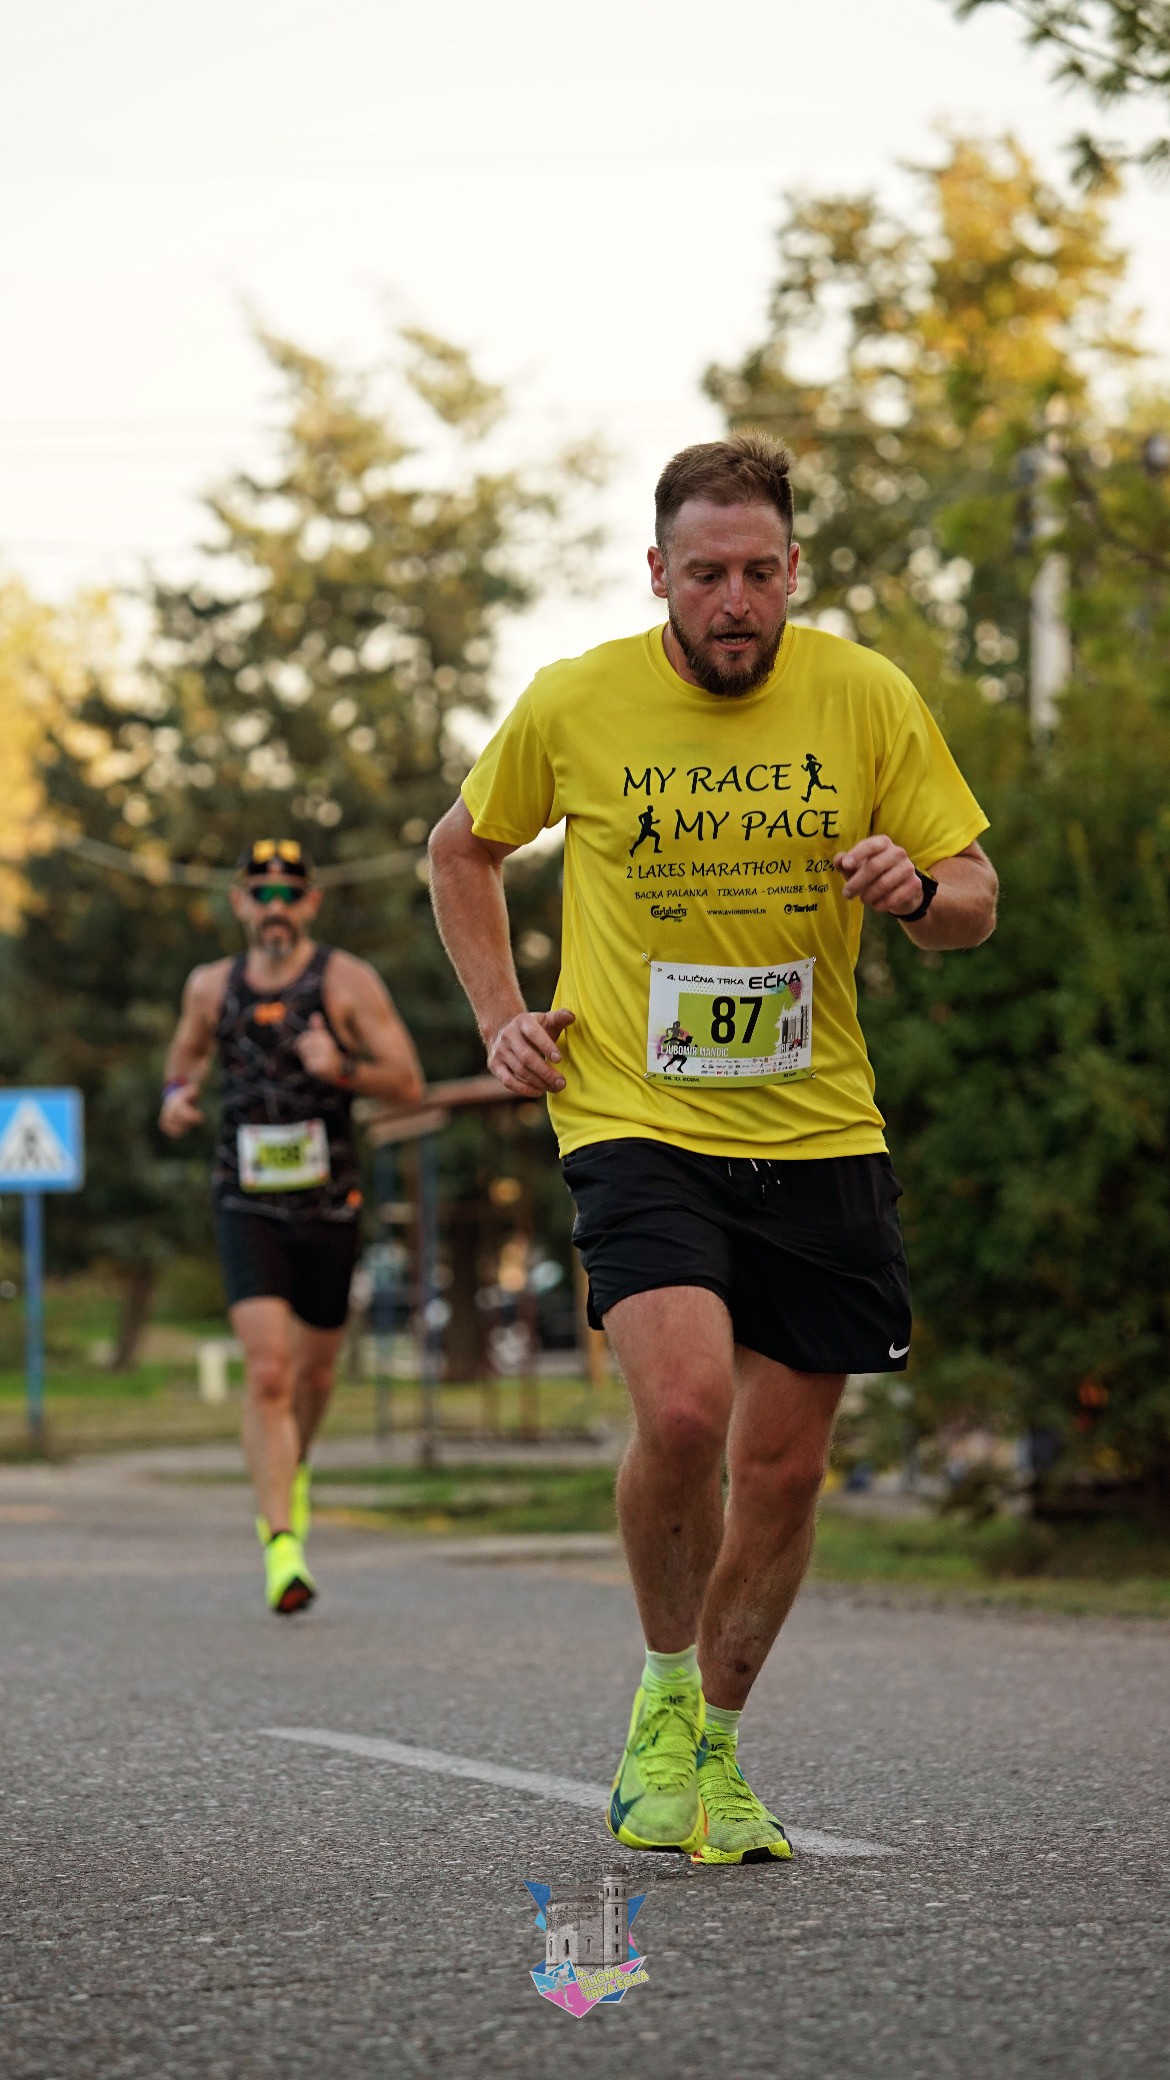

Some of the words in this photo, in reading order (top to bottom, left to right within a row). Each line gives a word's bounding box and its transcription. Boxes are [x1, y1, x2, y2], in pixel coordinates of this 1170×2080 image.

[623, 766, 676, 797] MY
[687, 763, 792, 794] RACE
[675, 809, 730, 841] MY
[741, 809, 840, 841] PACE
[626, 866, 633, 879] 2
[638, 862, 686, 879] LAKES
[691, 859, 792, 877] MARATHON
[634, 890, 664, 900] BACKA
[666, 888, 709, 898] PALANKA
[717, 887, 758, 897] TIKVARA
[650, 904, 688, 919] Carlsberg
[666, 974, 676, 982] 4.
[678, 974, 715, 985] ULIČNA
[716, 977, 745, 986] TRKA
[748, 971, 801, 990] EČKA
[710, 996, 763, 1044] 87
[660, 1044, 698, 1056] LJUBOMIR
[699, 1046, 730, 1058] MANDIĆ
